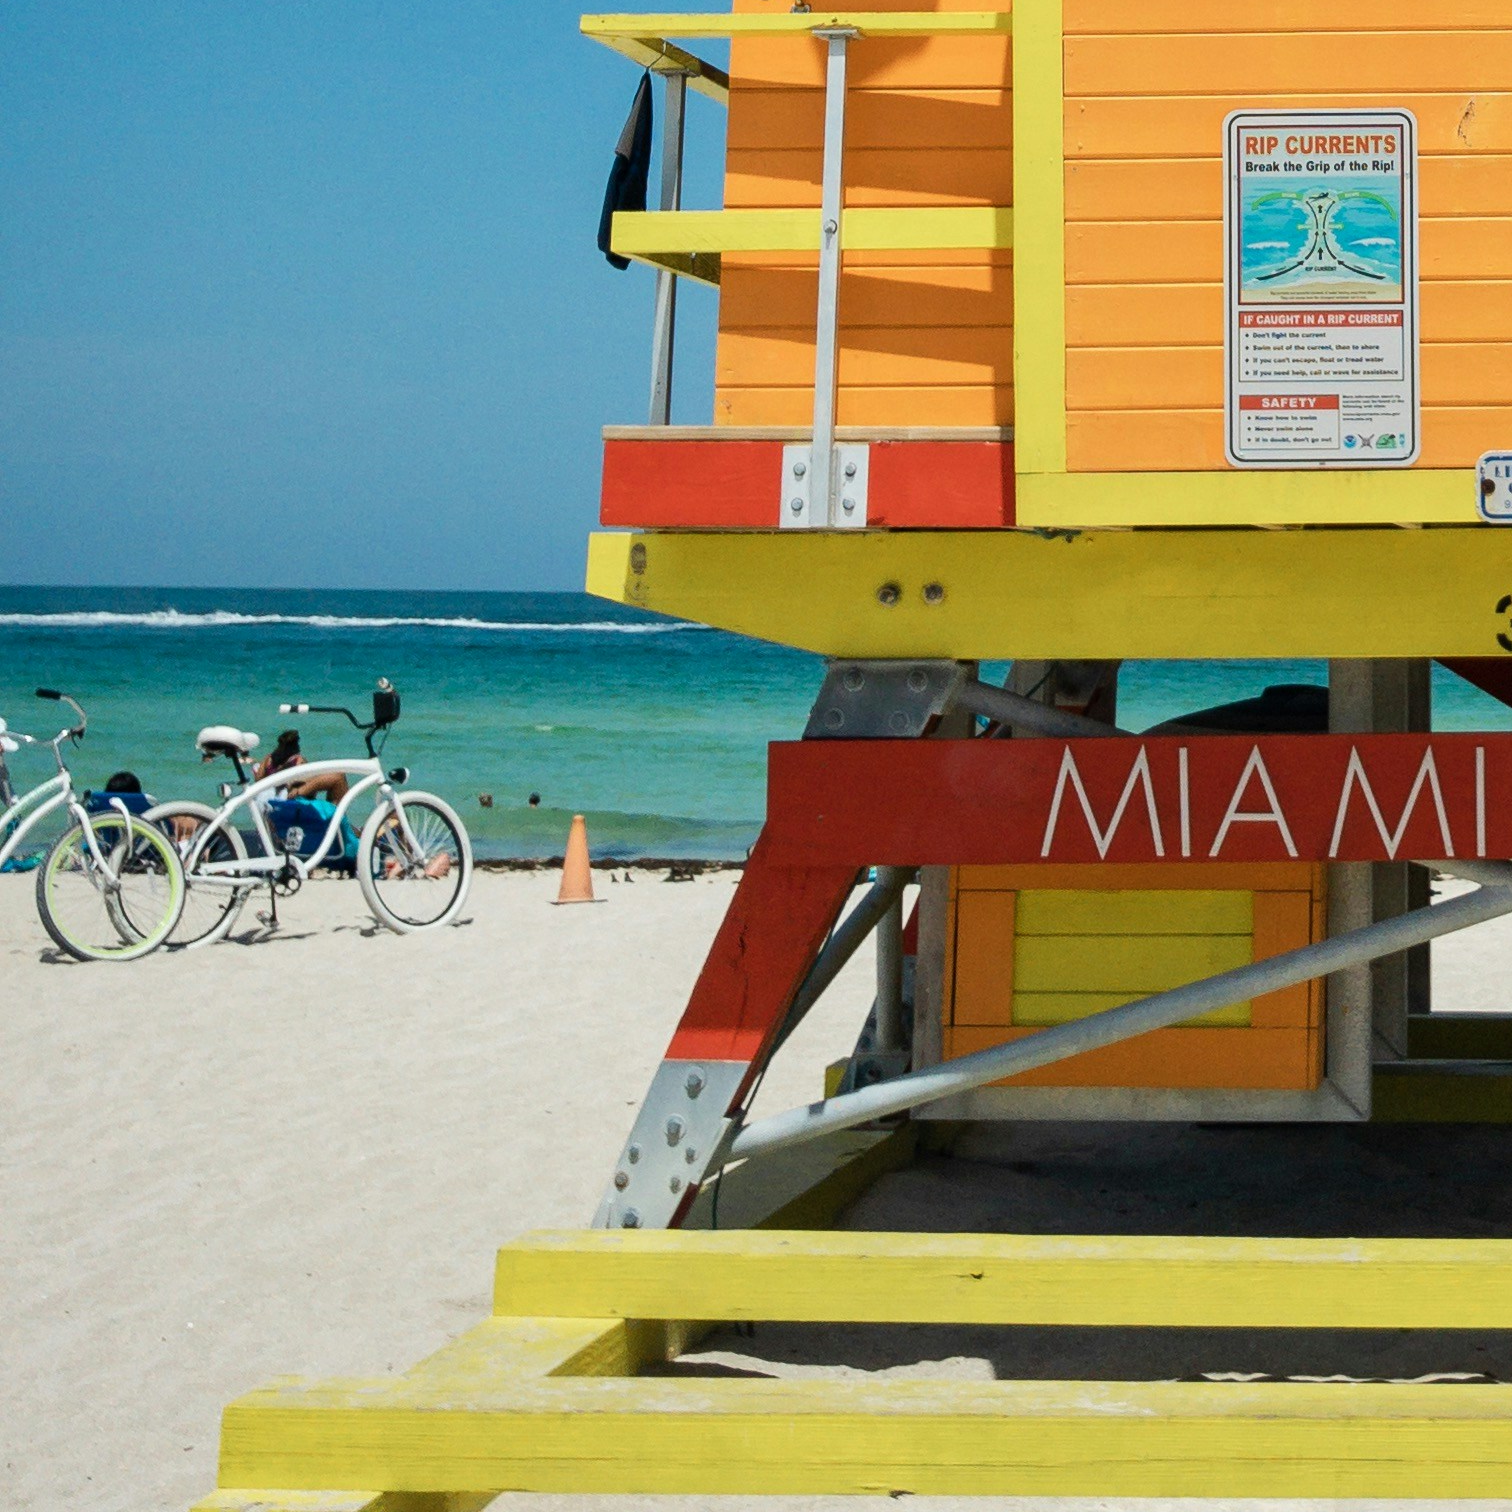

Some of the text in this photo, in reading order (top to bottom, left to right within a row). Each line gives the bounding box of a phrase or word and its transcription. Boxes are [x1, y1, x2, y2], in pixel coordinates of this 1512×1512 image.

[1245, 134, 1396, 155] RIP CURRENTS
[1245, 160, 1394, 174] Break the Grip of the Rip!
[1243, 313, 1399, 325] IF CAUGHT IN A RIP CURRENT
[1261, 397, 1317, 408] SAFETY
[1041, 744, 1486, 861] MIAMI
